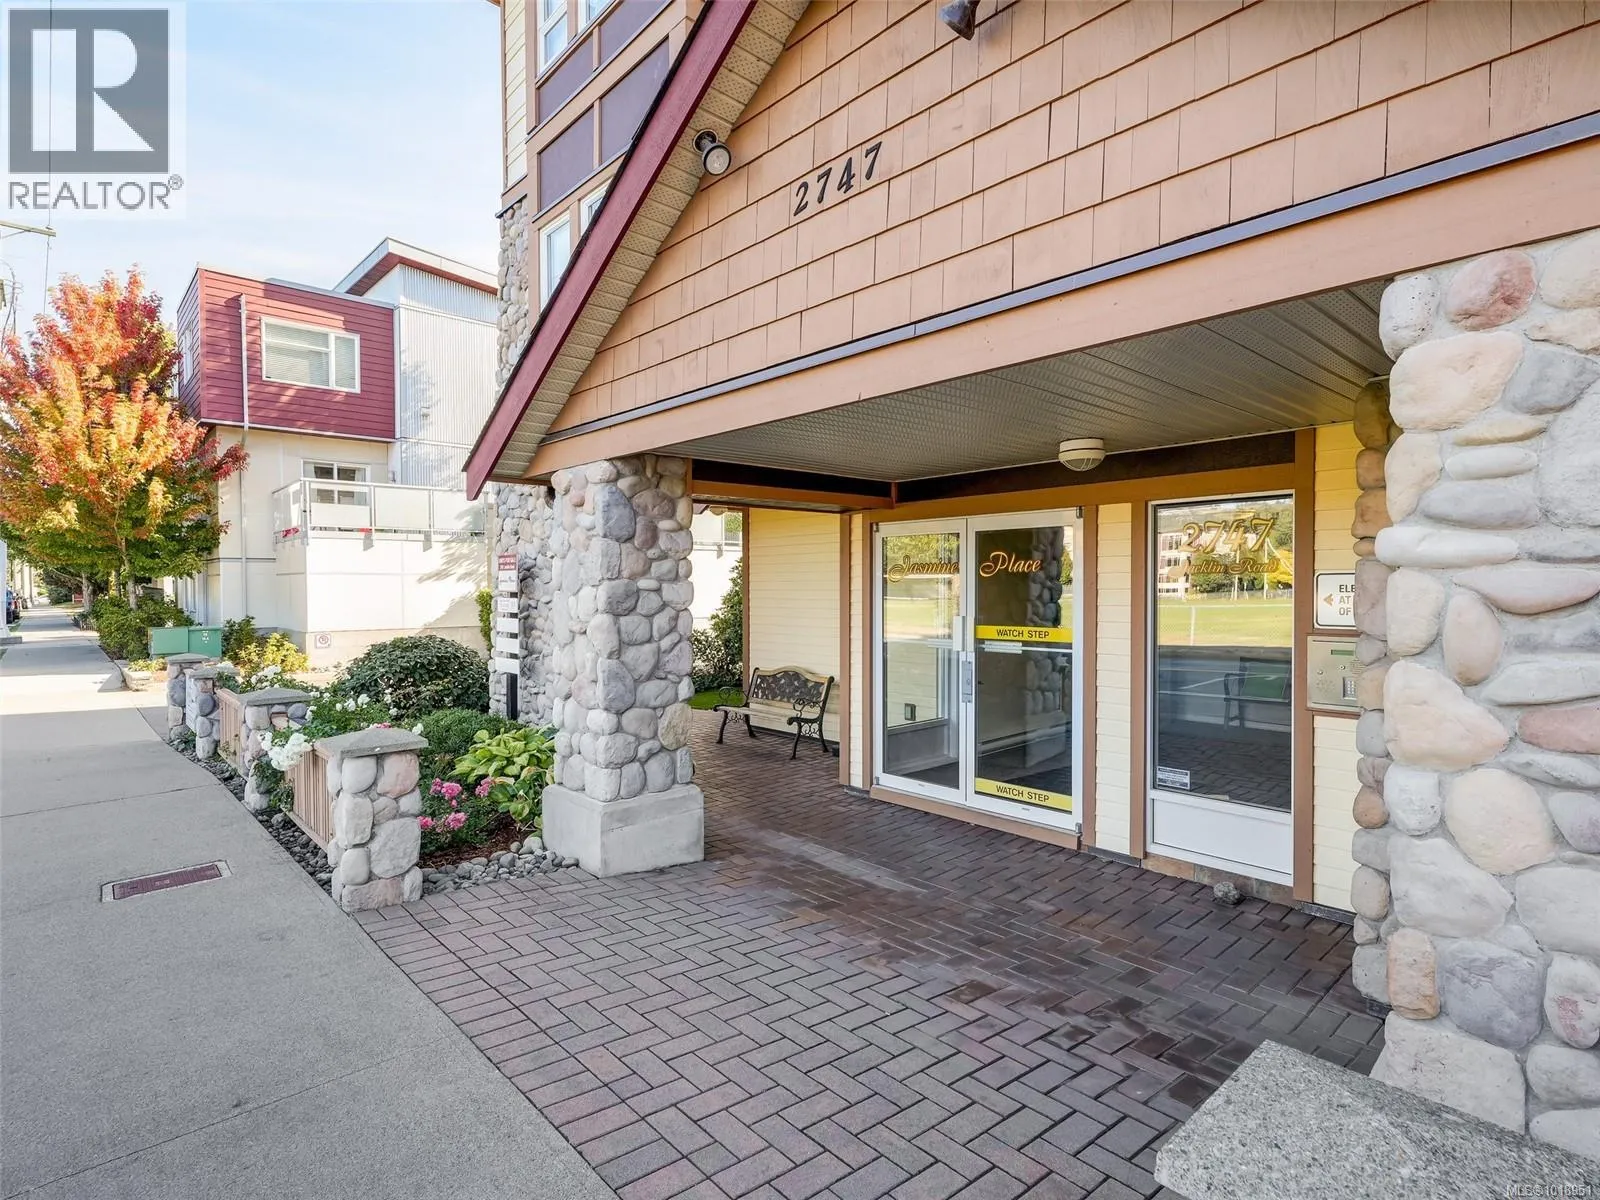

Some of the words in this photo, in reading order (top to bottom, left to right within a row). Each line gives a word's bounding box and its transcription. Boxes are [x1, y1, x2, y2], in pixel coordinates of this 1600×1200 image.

[793, 141, 883, 217] 2747
[1179, 518, 1276, 555] 2747
[887, 554, 960, 583] Jasmine
[979, 551, 1042, 578] Place
[1169, 558, 1226, 576] acklin
[1229, 557, 1281, 575] Road
[1338, 595, 1352, 605] AT
[1338, 607, 1352, 616] OF
[996, 628, 1024, 638] WATCH
[1027, 630, 1050, 639] STEP
[995, 784, 1024, 798] WATCH
[1027, 791, 1050, 803] STEP
